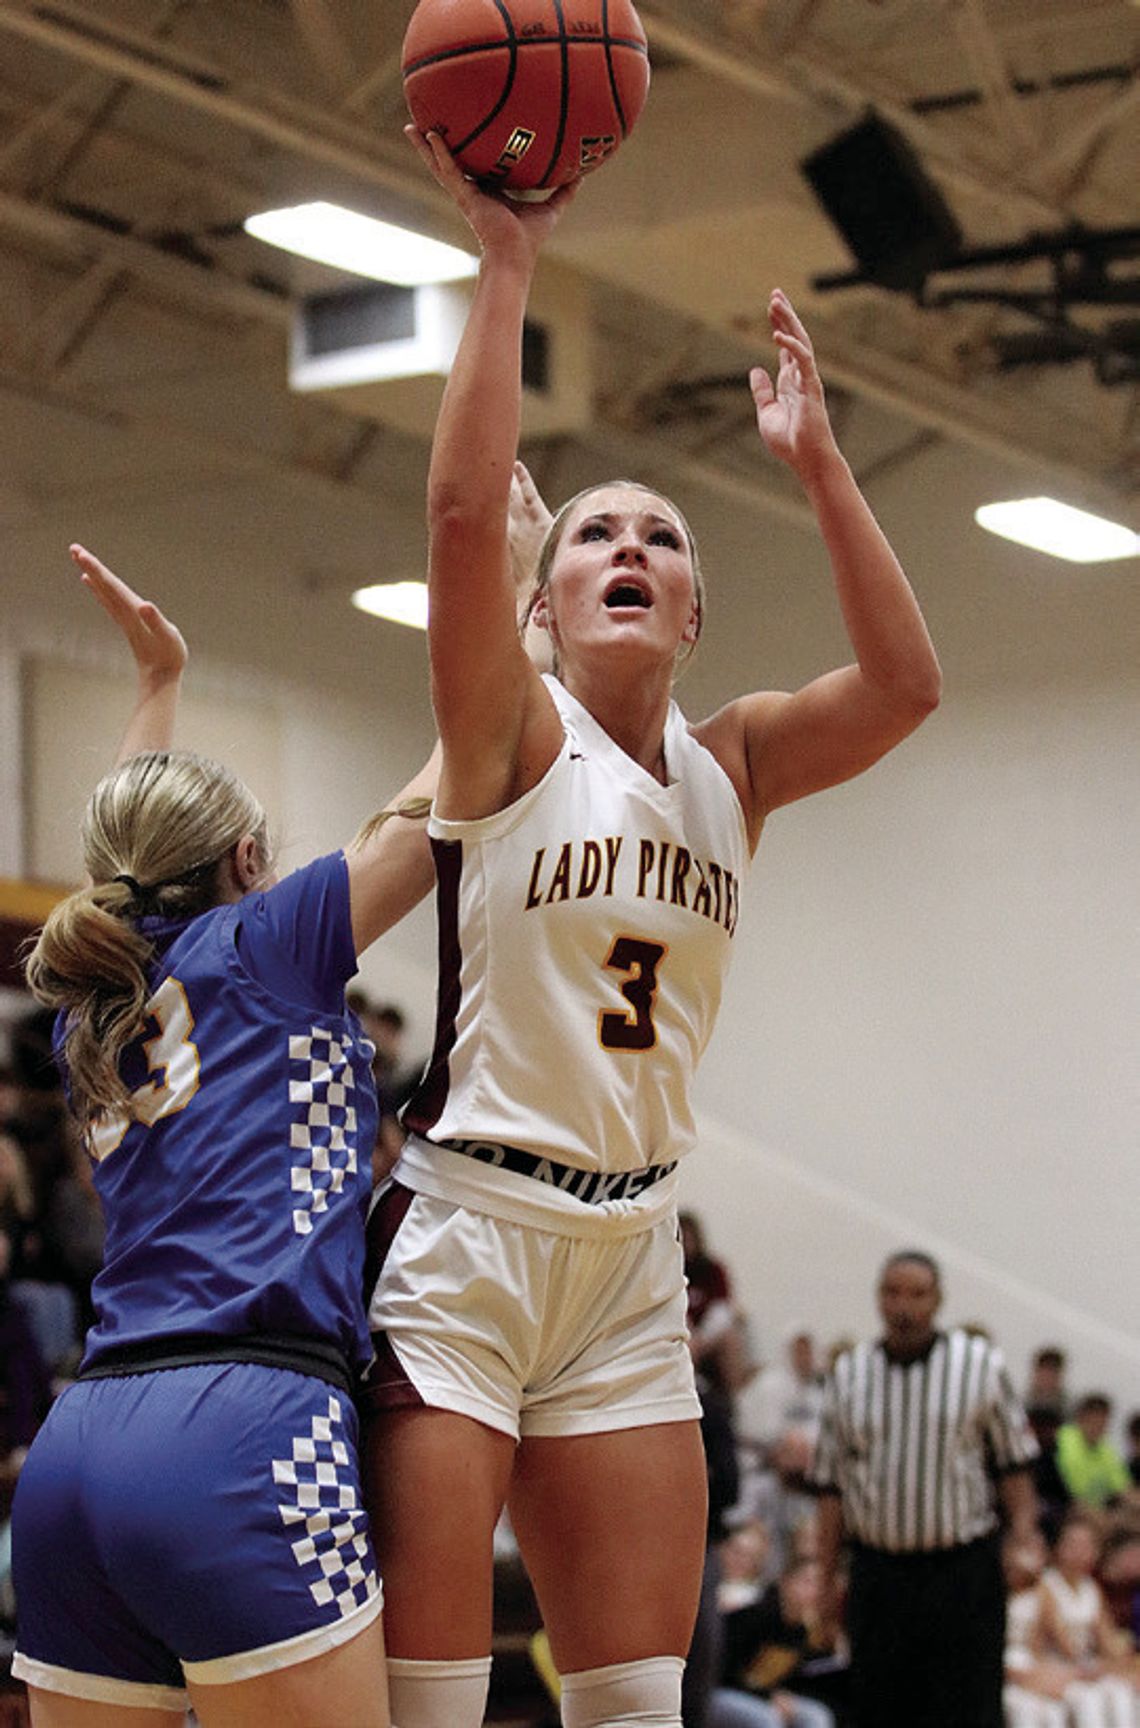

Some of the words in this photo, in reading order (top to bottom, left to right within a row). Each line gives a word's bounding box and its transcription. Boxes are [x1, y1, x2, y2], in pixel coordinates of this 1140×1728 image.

[525, 836, 623, 912] LADY
[597, 933, 669, 1054] 3
[84, 976, 200, 1163] 3
[532, 1157, 649, 1205] NIKE
